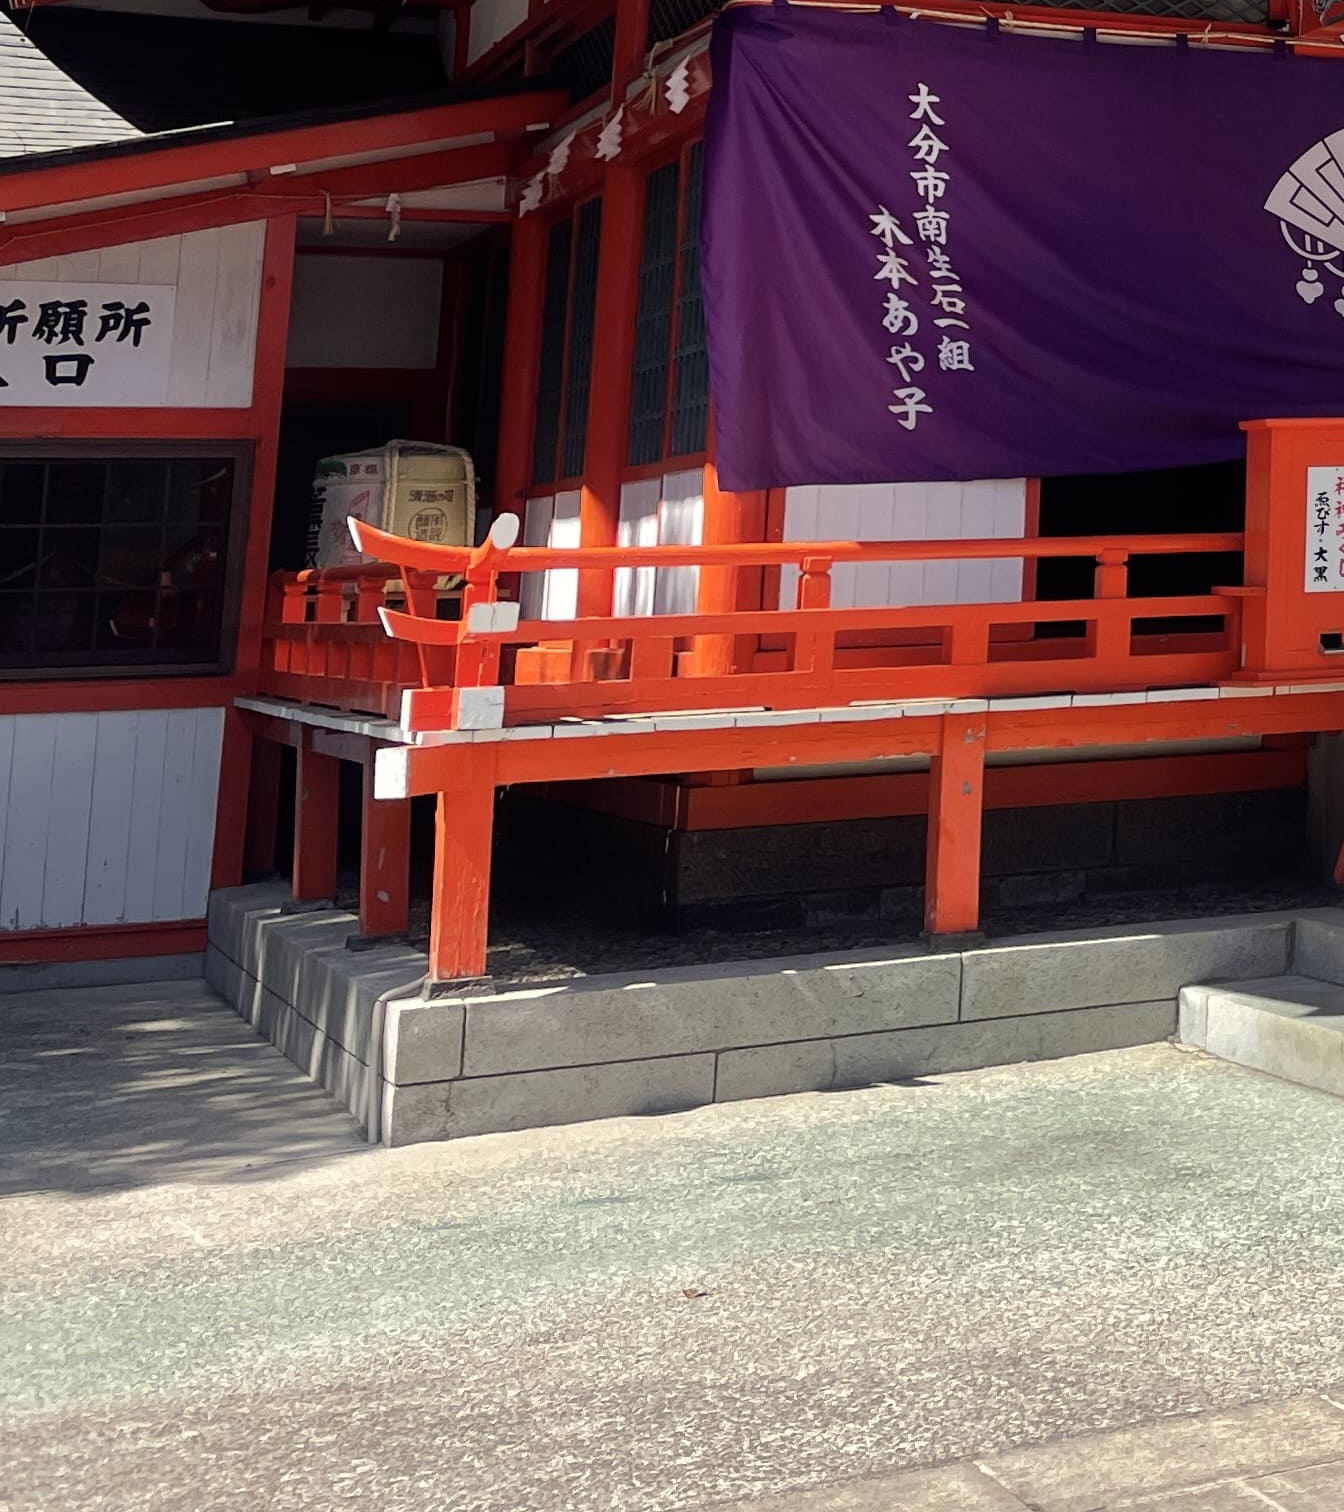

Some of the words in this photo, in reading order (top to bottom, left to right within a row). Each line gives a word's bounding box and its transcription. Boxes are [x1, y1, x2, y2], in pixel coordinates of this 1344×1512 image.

[0, 353, 95, 386] 口
[868, 204, 934, 431] 木本あや子
